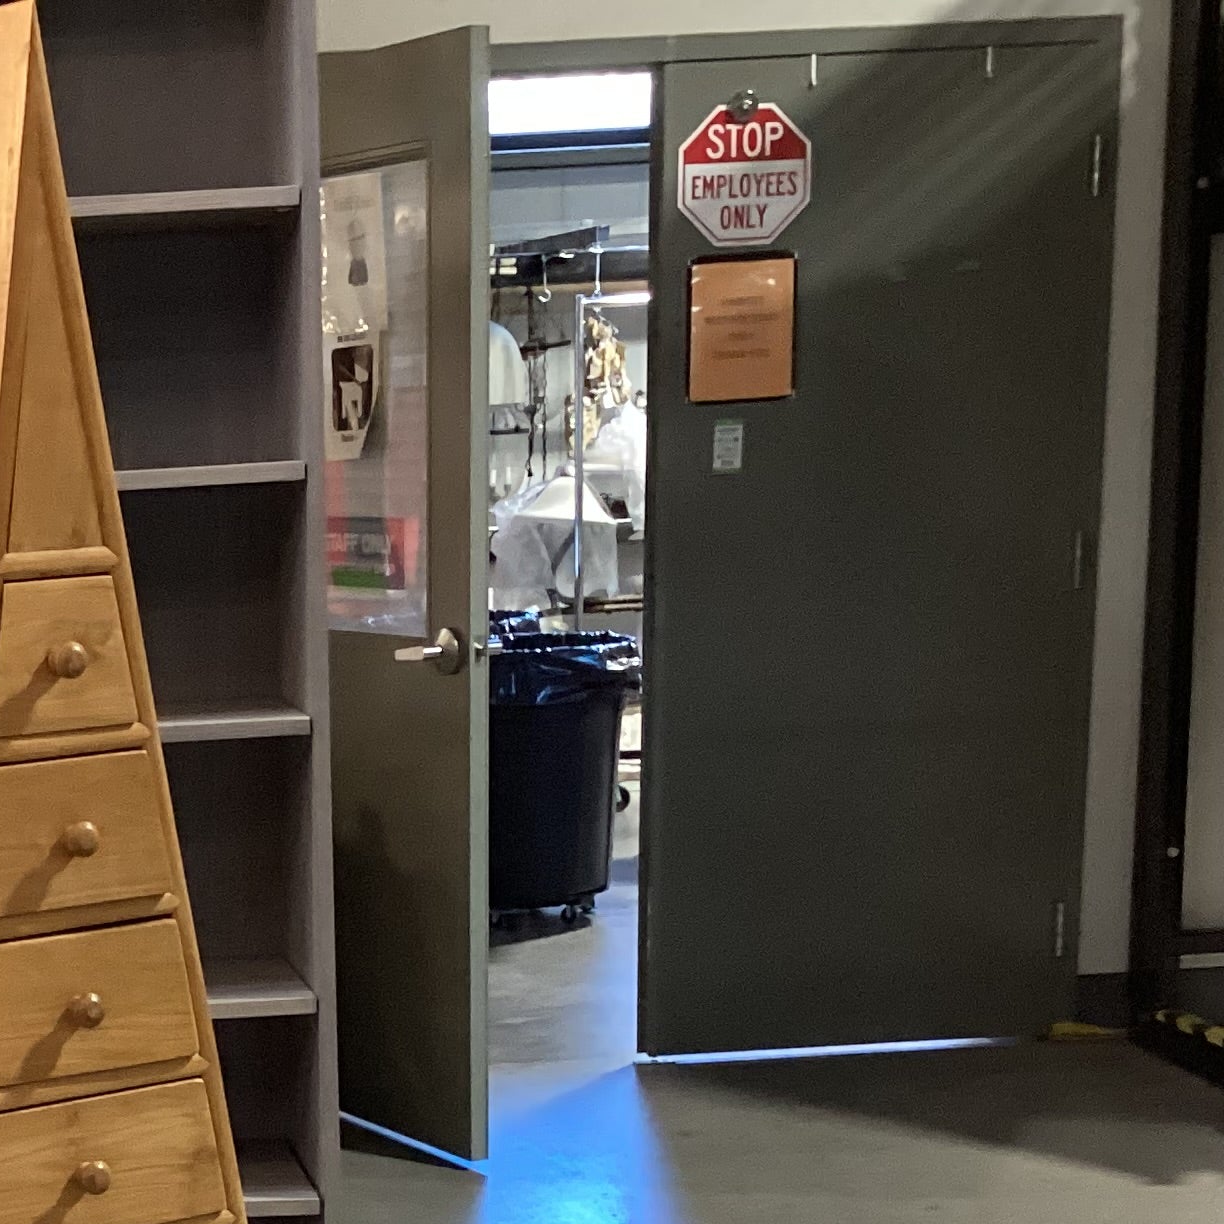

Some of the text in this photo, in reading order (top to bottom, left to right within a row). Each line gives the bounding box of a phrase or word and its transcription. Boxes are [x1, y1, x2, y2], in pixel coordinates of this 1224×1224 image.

[706, 121, 784, 159] STOP
[691, 171, 797, 200] EMPLOYEES
[720, 204, 767, 230] ONLY
